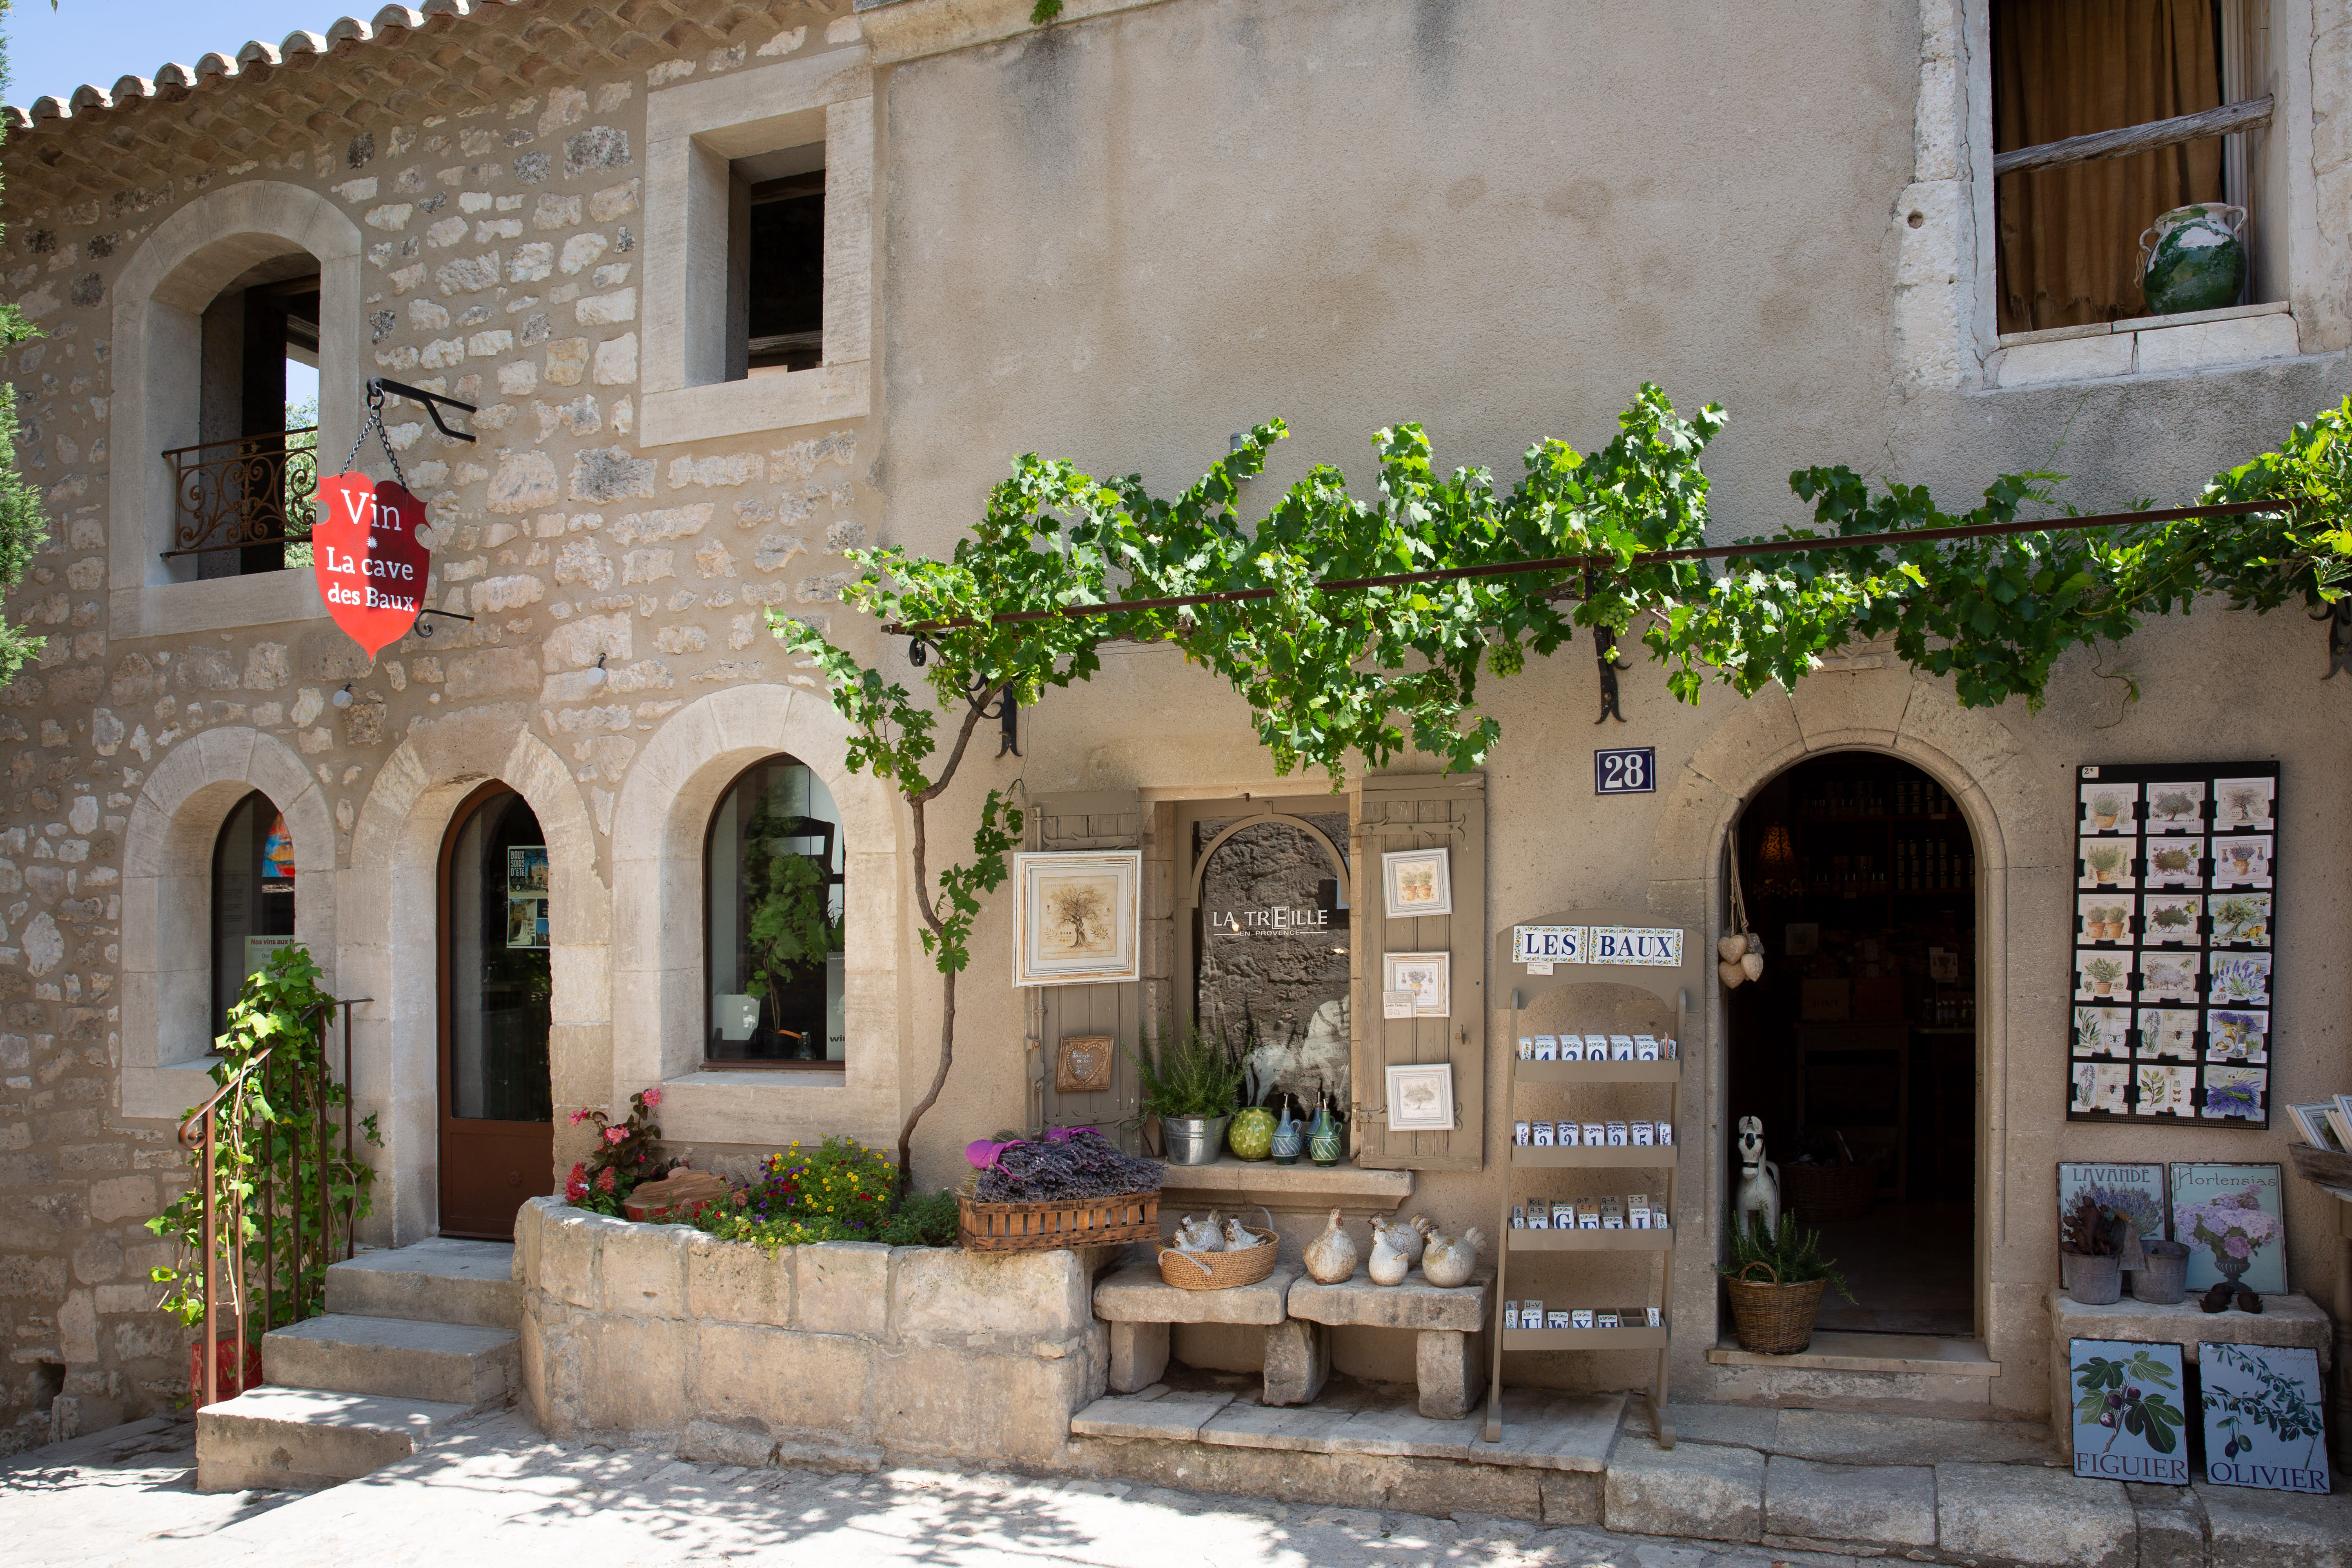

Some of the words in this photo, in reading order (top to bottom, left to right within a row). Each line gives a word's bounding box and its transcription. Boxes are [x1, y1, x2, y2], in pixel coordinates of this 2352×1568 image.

[341, 489, 402, 531] Vin
[326, 546, 355, 574] La
[361, 558, 414, 581] cave
[327, 582, 360, 605] des
[365, 586, 415, 612] Baux
[1604, 754, 1644, 788] 28
[510, 851, 525, 860] BAUX
[510, 860, 525, 868] SOIRS
[511, 868, 525, 876] D'ÉTÉ
[1213, 911, 1236, 927] LA
[1244, 907, 1328, 928] TREILLE
[1524, 933, 1577, 956] LES
[1600, 935, 1673, 958] BAUX
[2073, 1168, 2150, 1182] LAVANDE
[2174, 1167, 2277, 1191] Hortensias
[2075, 1452, 2188, 1480] FIGUIER
[2210, 1462, 2328, 1490] OLIVIER
